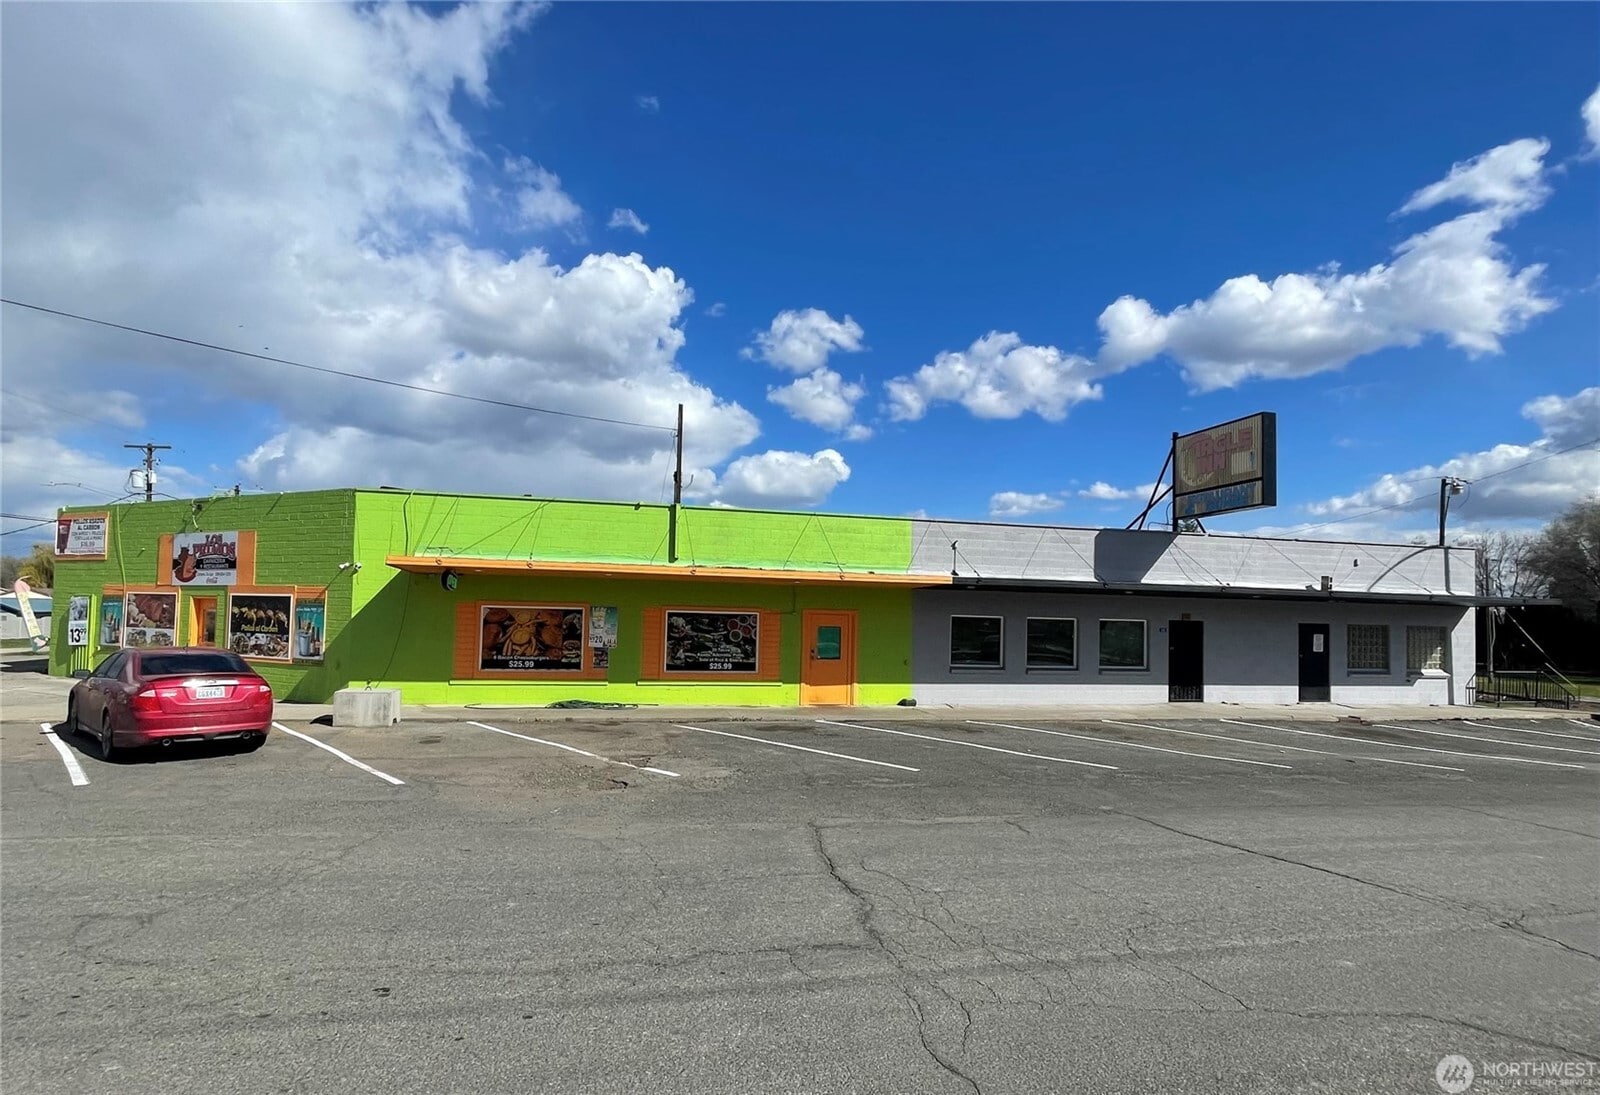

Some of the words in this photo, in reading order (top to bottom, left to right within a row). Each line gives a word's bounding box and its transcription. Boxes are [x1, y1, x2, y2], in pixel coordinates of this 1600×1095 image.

[205, 534, 223, 546] LOS
[193, 542, 236, 560] PRIMOS
[70, 628, 81, 643] 13
[509, 660, 534, 668] $25.99
